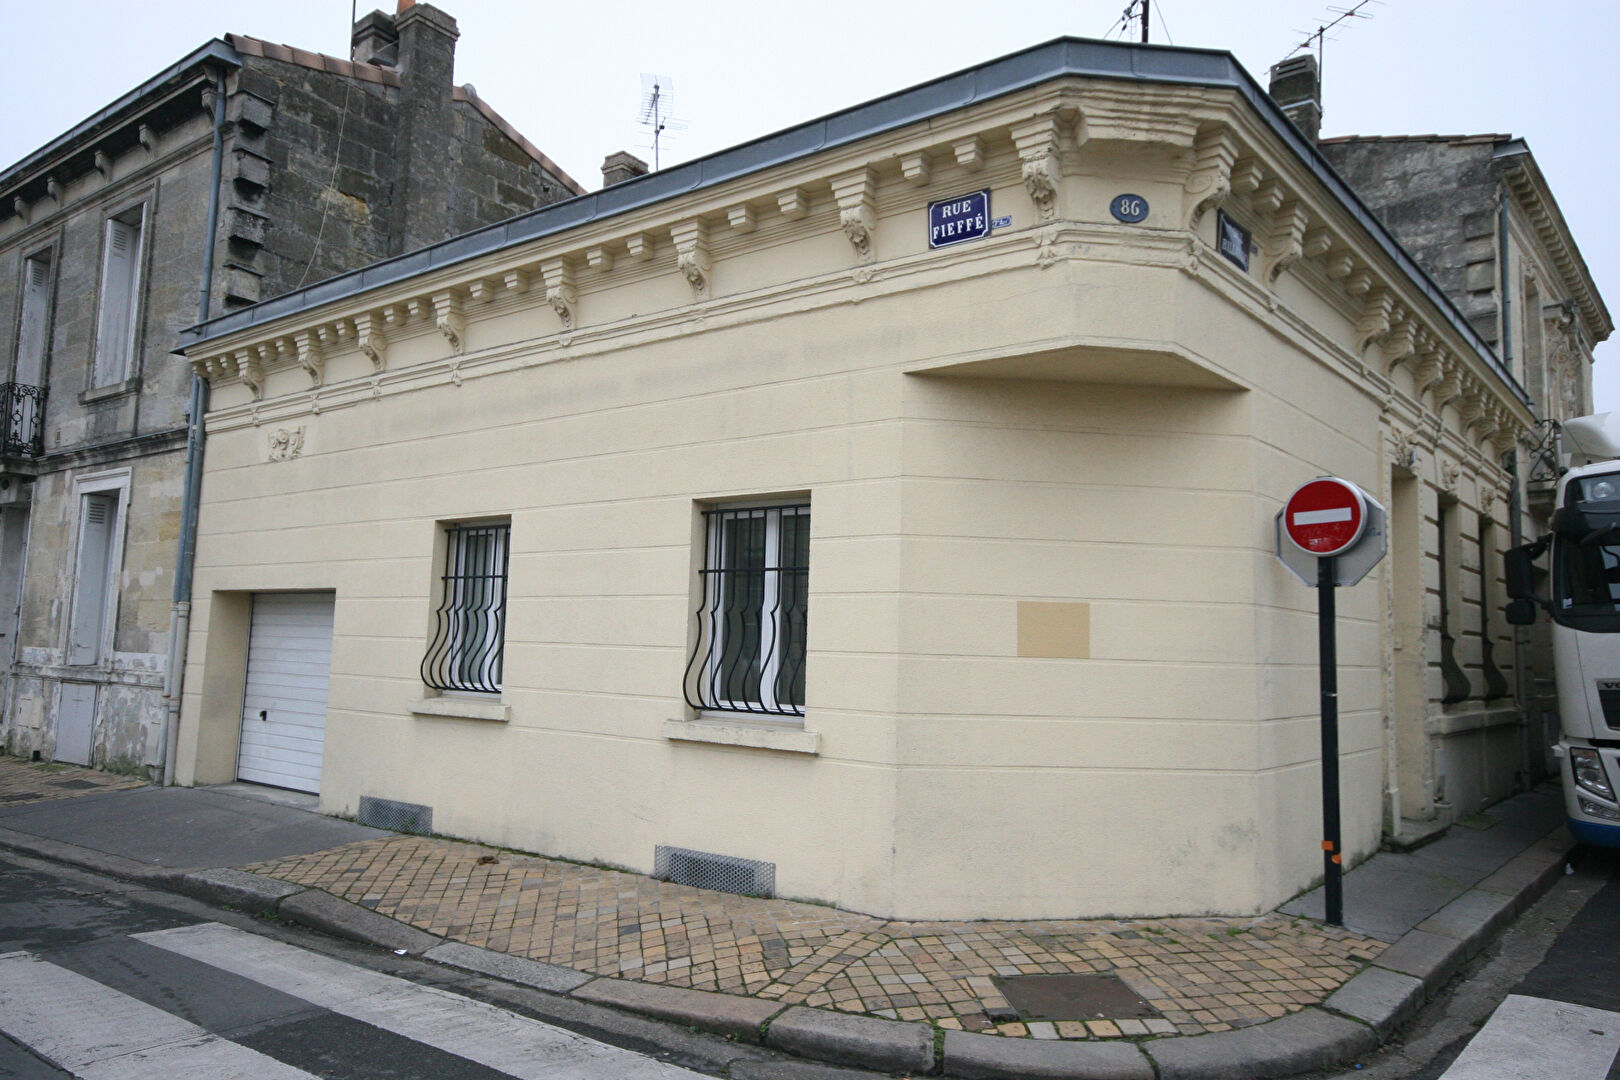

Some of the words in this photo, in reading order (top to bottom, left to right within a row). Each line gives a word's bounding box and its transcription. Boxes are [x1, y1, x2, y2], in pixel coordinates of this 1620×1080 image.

[942, 200, 971, 218] RUE
[1121, 199, 1140, 216] 86
[933, 213, 983, 239] FIEFFÉ
